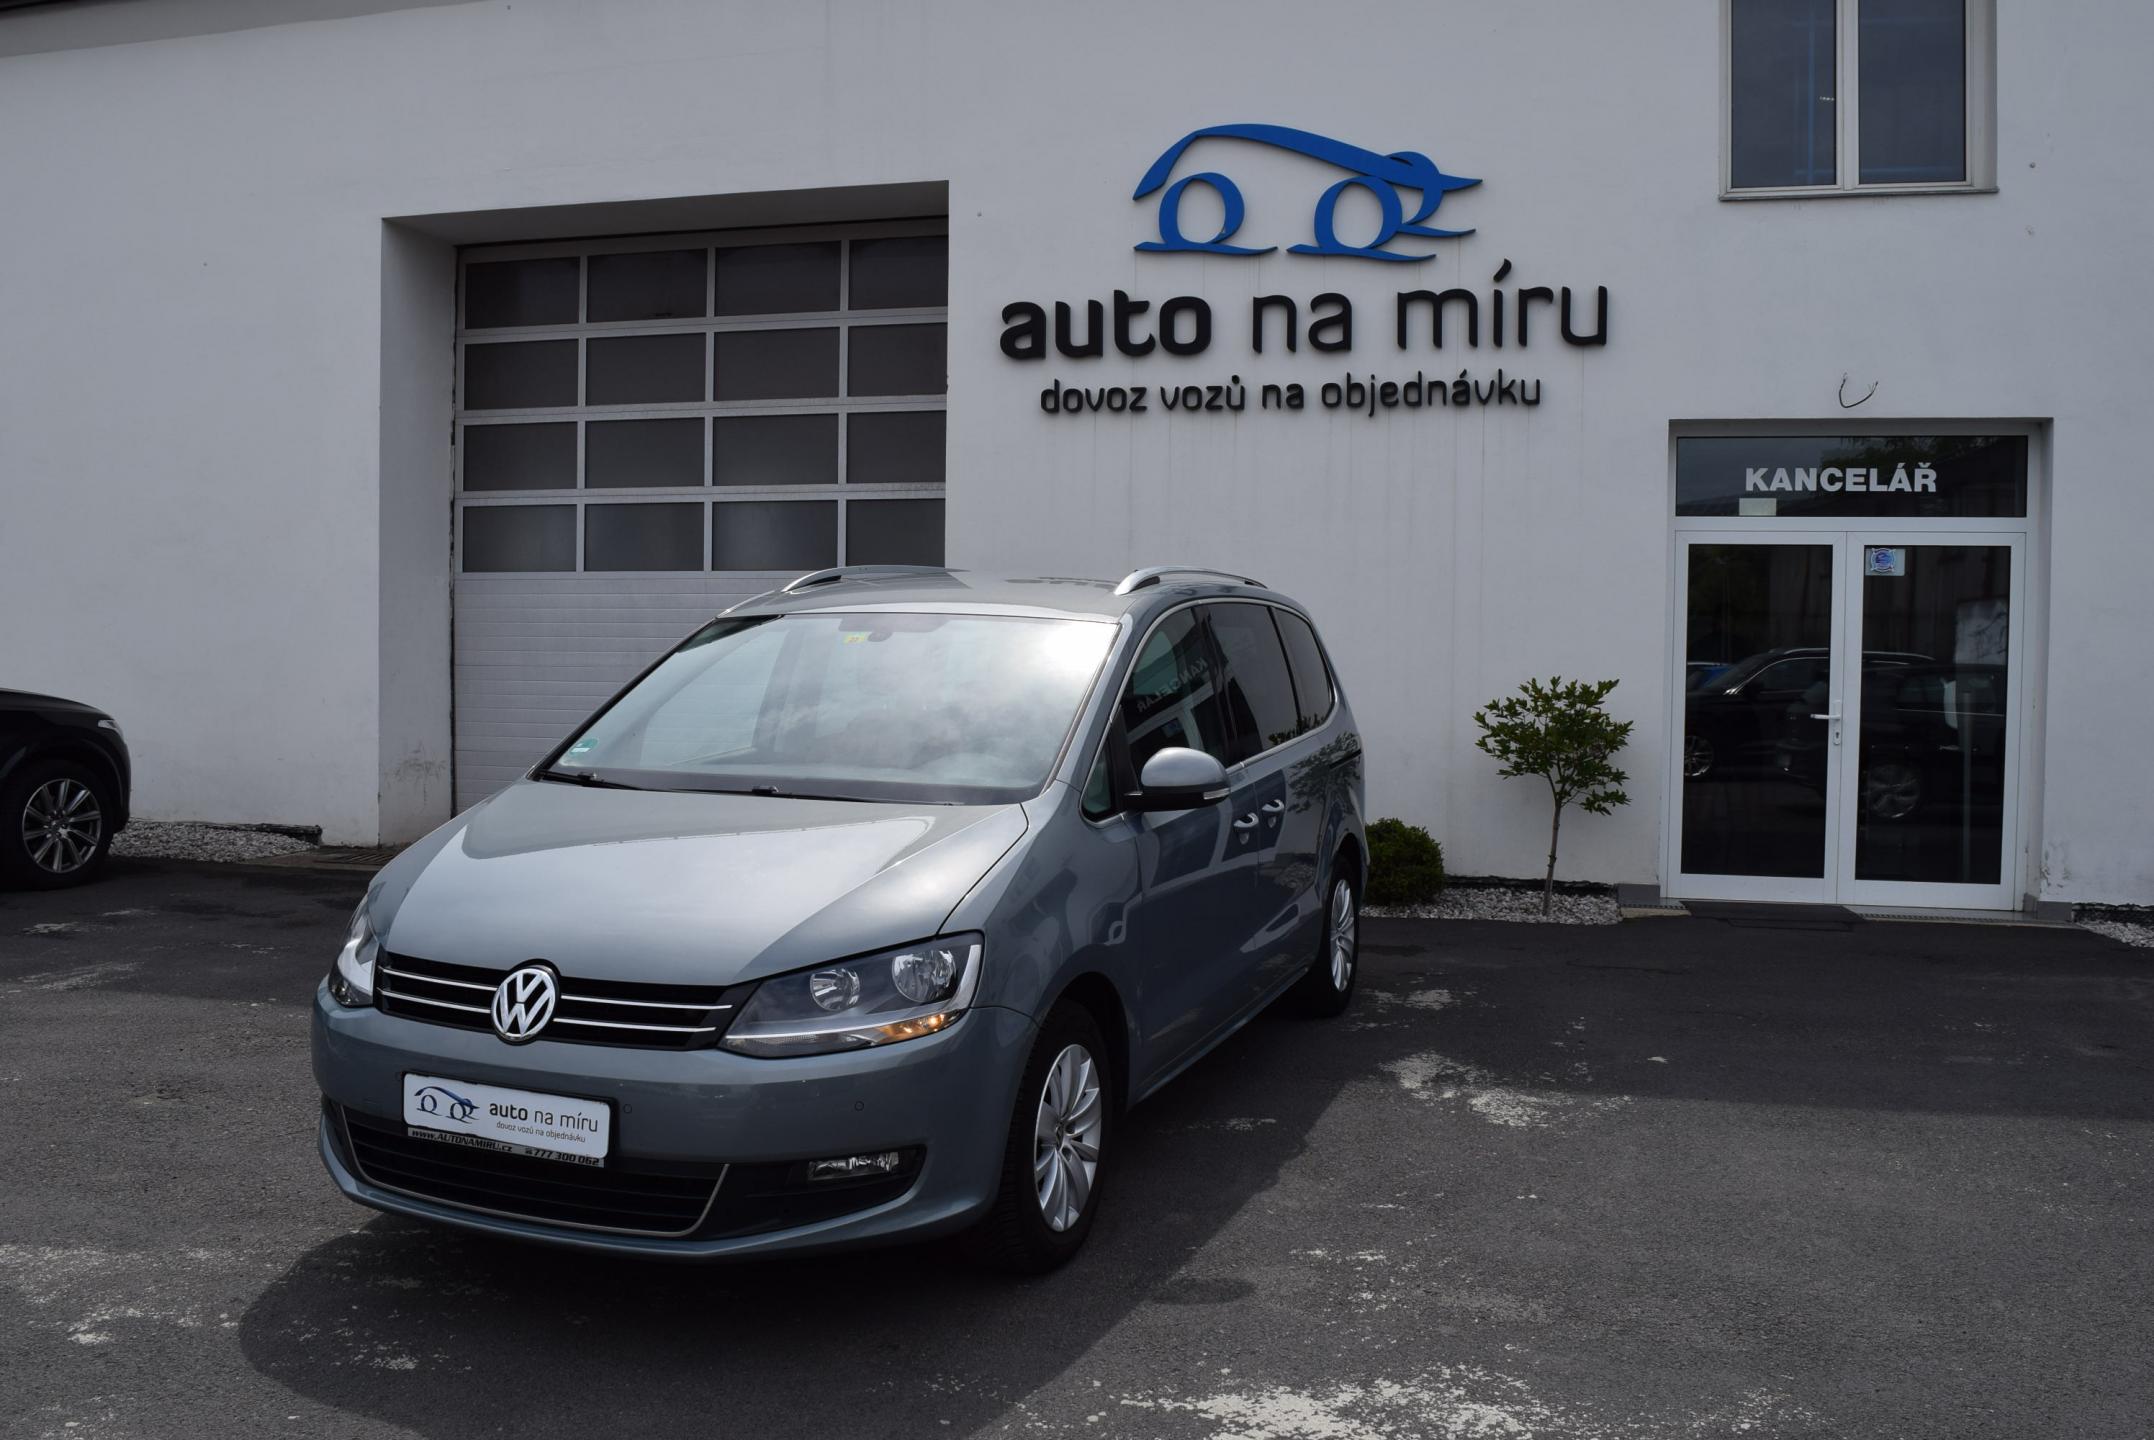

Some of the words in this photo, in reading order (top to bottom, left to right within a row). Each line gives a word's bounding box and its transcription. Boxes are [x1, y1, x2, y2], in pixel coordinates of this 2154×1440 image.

[1000, 289, 1211, 360] auto
[1252, 292, 1352, 353] na
[1397, 258, 1607, 350] míru
[1041, 378, 1147, 414] dovoz
[1160, 374, 1245, 412] vozů
[1262, 383, 1304, 411] na
[1321, 368, 1541, 418] objednávku
[1745, 462, 1936, 493] KANCELÁŘ
[489, 1102, 528, 1121] auto
[534, 1110, 554, 1125] na
[560, 1111, 598, 1132] míru
[496, 1121, 516, 1132] dovoz
[545, 1130, 586, 1143] objednávku
[555, 1151, 576, 1162] 300
[577, 1155, 600, 1166] 062
